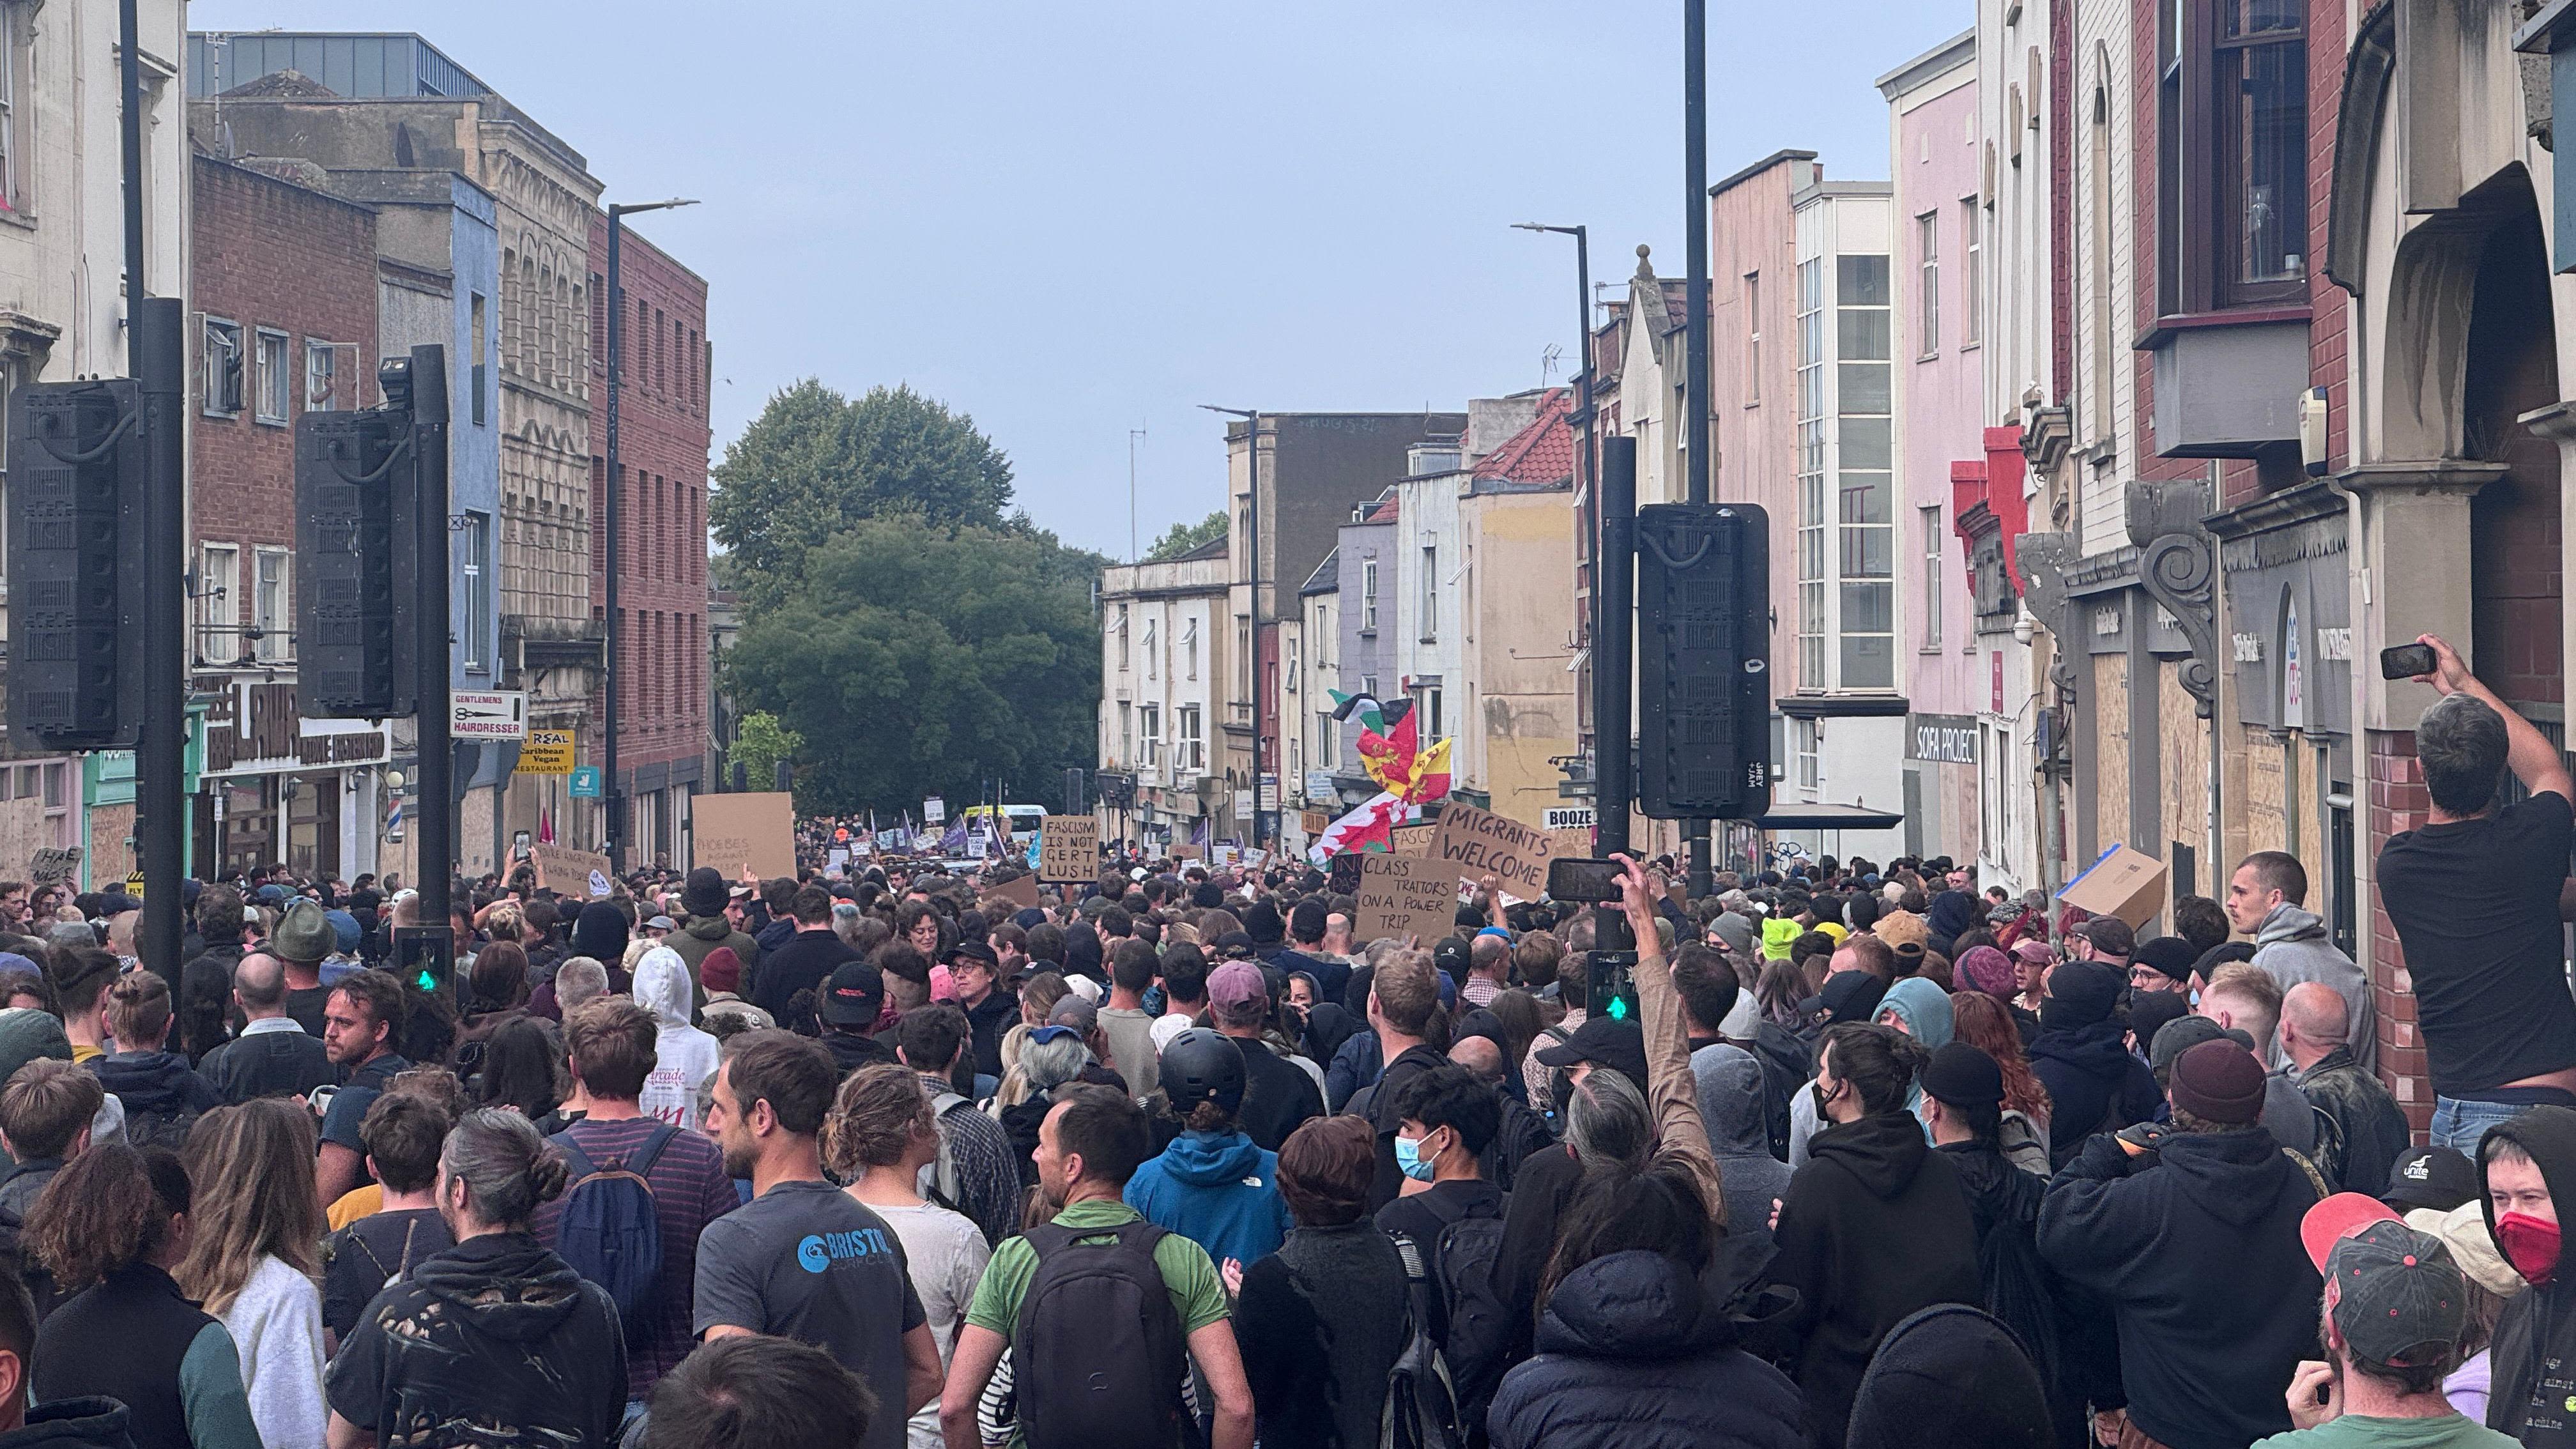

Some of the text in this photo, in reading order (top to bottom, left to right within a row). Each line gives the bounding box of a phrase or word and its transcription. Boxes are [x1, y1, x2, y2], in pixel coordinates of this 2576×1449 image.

[456, 695, 502, 703] GENTLEMENS
[454, 722, 519, 733] HAIRDRESSER
[533, 733, 569, 745] REAL
[1917, 726, 1978, 763] SOFA PROJECT
[521, 747, 564, 755] Caribbean
[1549, 810, 1591, 825] BOOZE
[1046, 821, 1095, 834] FASCISM
[1446, 808, 1552, 857] MIGRANTS
[1045, 836, 1094, 848] IS NOT
[1393, 827, 1435, 845] FASCIS
[1046, 848, 1094, 862] GERT
[1443, 834, 1543, 887] WELCOME
[1047, 864, 1093, 878] LUSH
[1364, 857, 1409, 876] CLASS
[1333, 875, 1359, 893] PAS
[1394, 879, 1449, 896] TRAITORS
[1362, 894, 1445, 913] ON A POWER
[1380, 914, 1410, 930] TRIP
[2404, 1167, 2429, 1176] unite
[2526, 1416, 2563, 1430] achine
